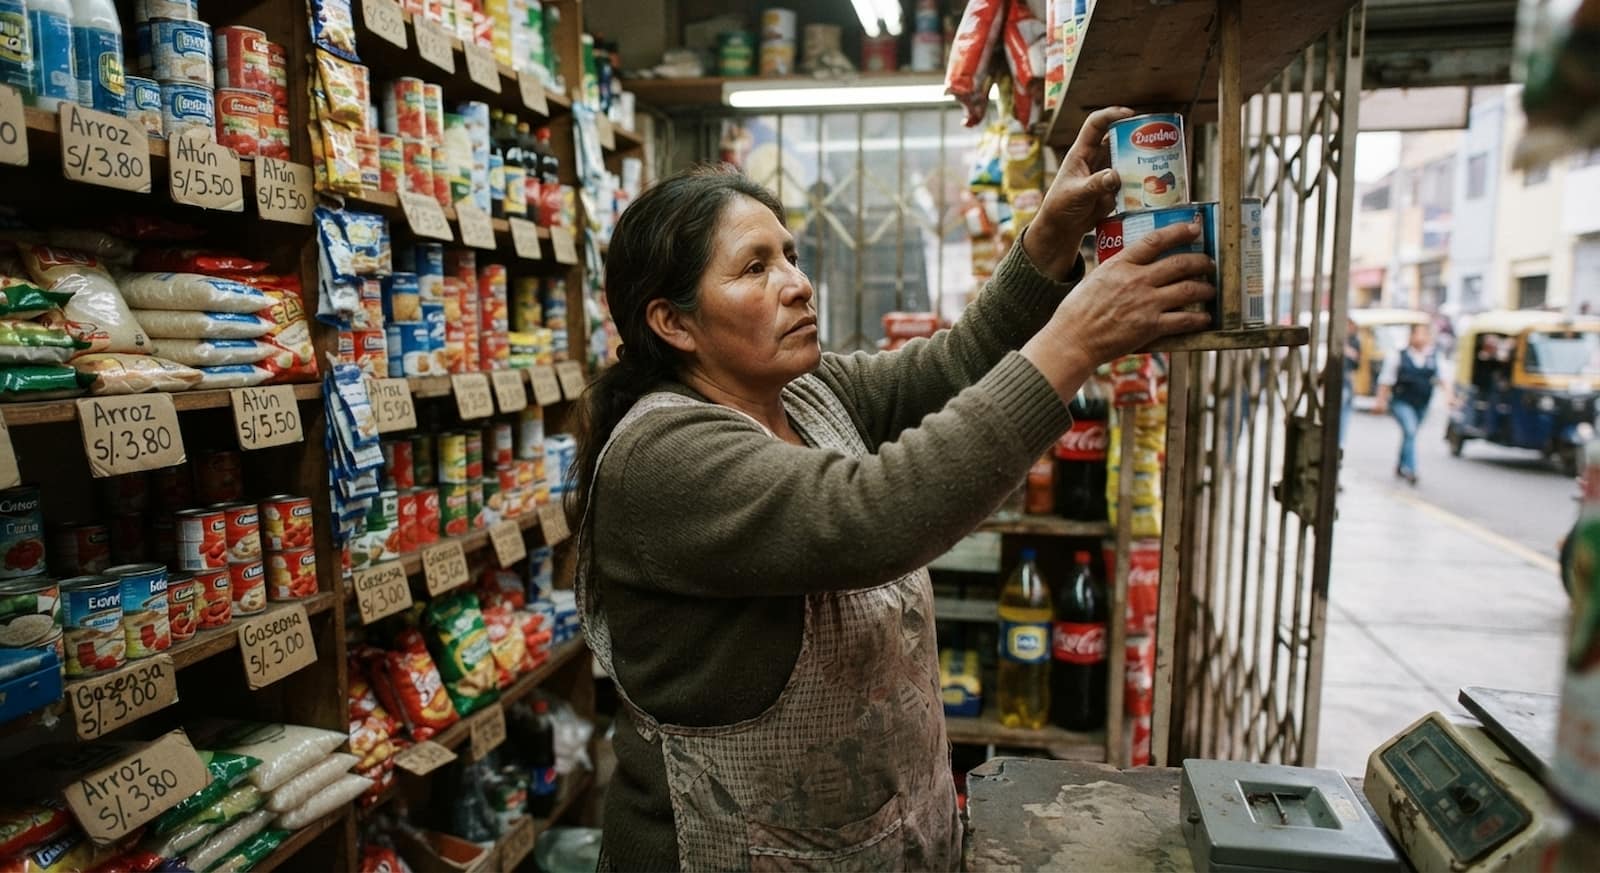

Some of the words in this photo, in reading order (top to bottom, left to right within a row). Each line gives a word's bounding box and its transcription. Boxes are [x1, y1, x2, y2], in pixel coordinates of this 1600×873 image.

[70, 105, 132, 146] Arroz
[177, 136, 217, 167] Atún
[263, 158, 295, 185] Atún
[94, 402, 156, 427] Arroz
[80, 757, 151, 806] Arroz
